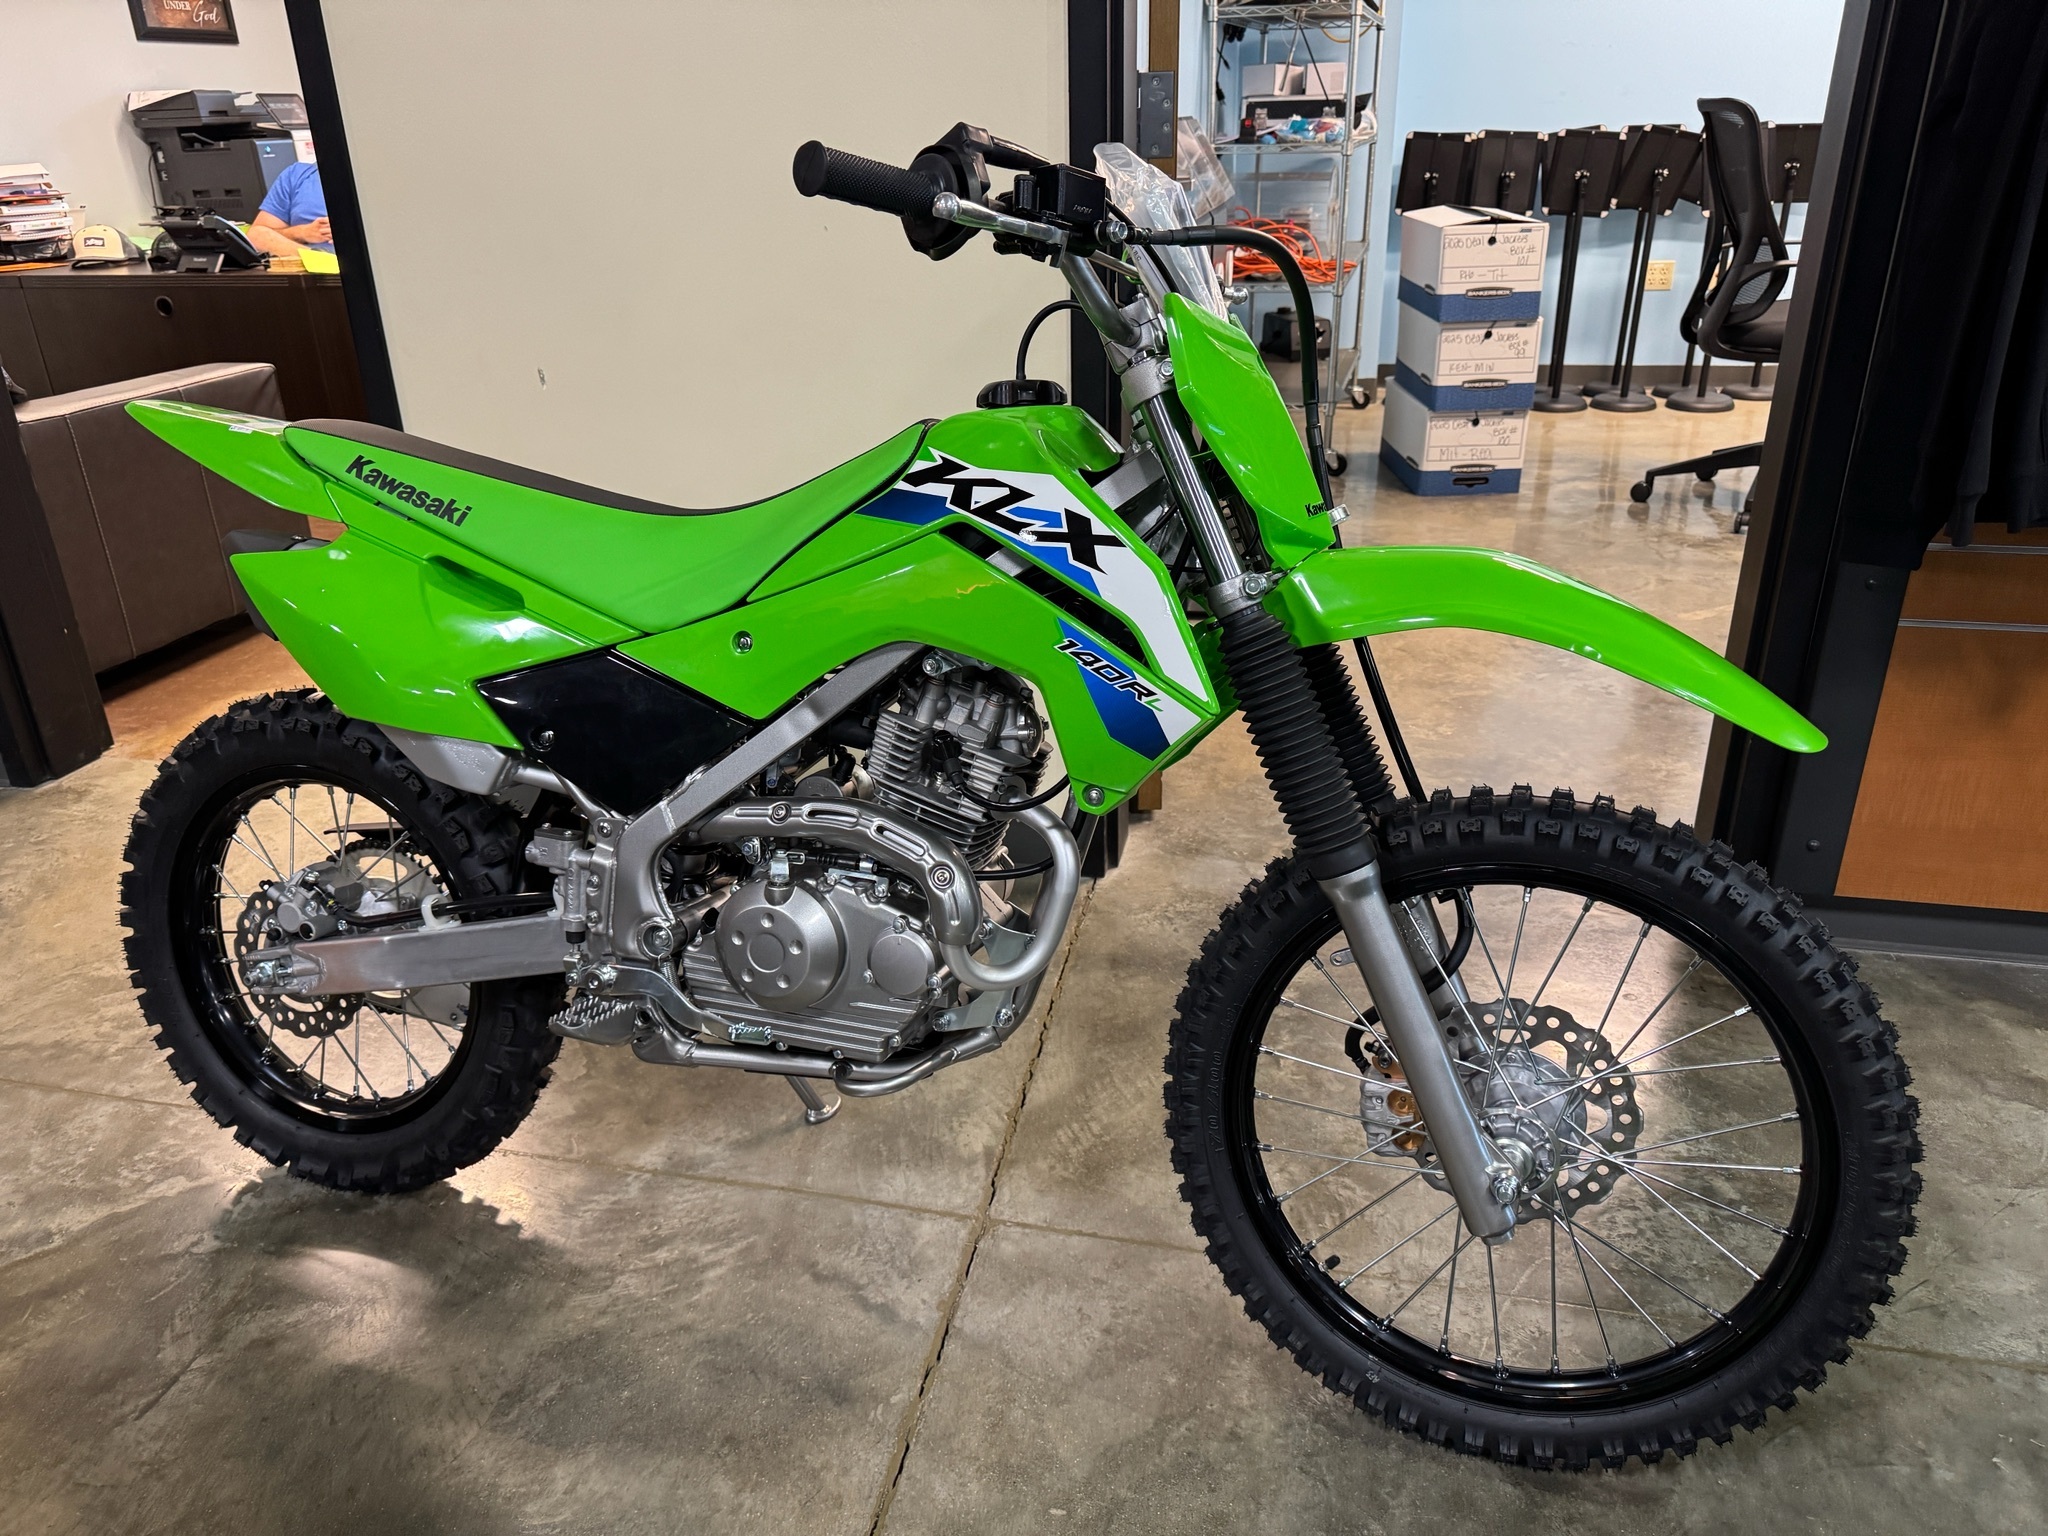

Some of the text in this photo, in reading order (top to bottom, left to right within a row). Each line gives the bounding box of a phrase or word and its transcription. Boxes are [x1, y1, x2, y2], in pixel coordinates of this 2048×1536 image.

[164, 0, 220, 27] UNDER God
[345, 455, 473, 527] Kawasaki
[899, 452, 1127, 577] KLX
